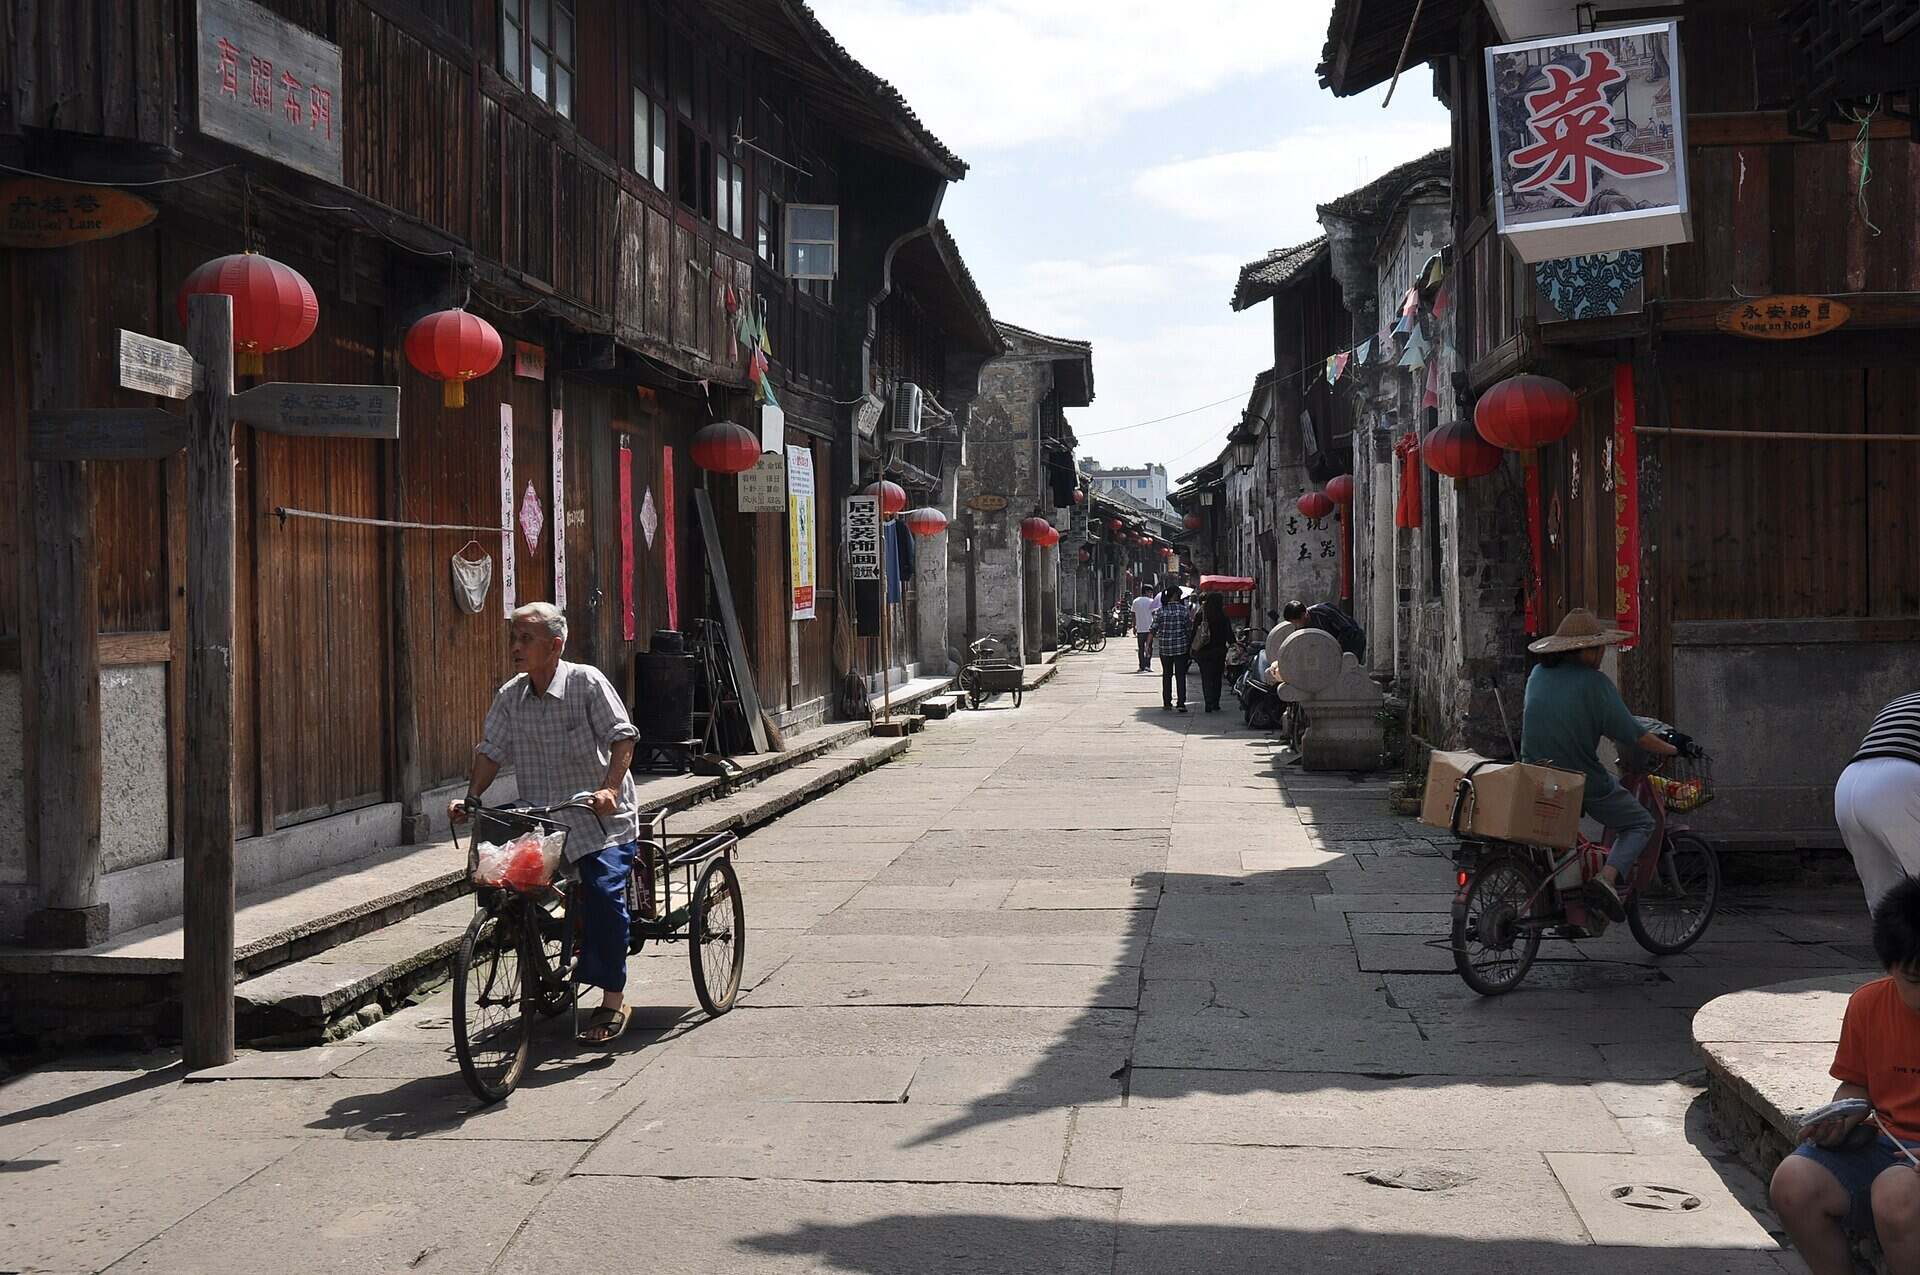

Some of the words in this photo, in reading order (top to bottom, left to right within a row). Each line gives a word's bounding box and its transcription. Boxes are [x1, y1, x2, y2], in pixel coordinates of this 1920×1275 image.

[1510, 47, 1668, 206] 菜
[1743, 303, 1811, 319] 永安路
[1783, 320, 1811, 331] Road
[281, 392, 361, 411] 永安路
